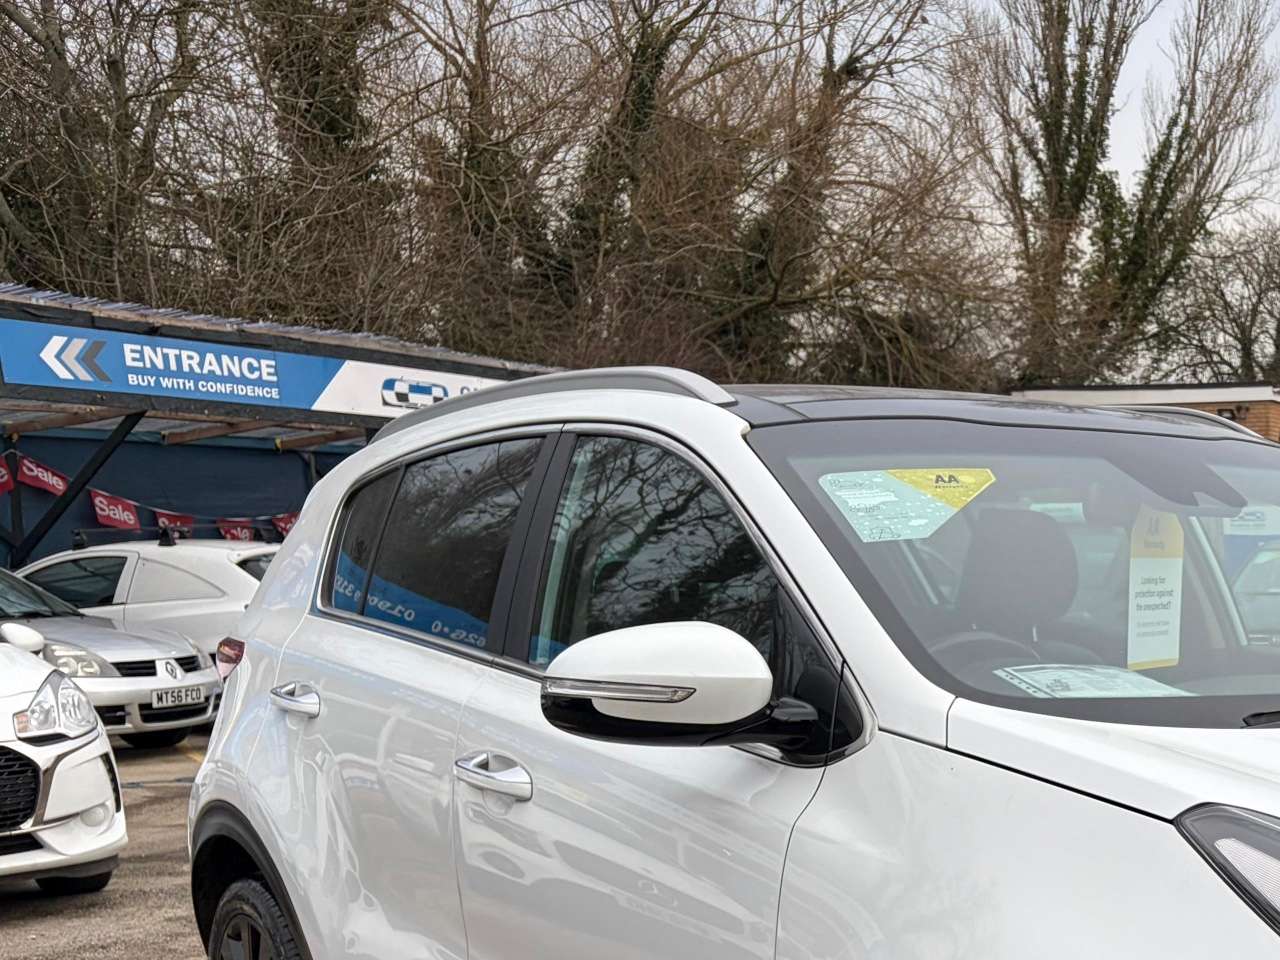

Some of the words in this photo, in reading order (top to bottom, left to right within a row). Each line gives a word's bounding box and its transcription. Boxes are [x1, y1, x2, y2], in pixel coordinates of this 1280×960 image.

[123, 343, 278, 382] ENTRANCE
[127, 373, 156, 388] BUY
[159, 376, 195, 391] WITH
[198, 380, 280, 399] CONFIDENCE
[22, 459, 65, 490] Sale
[93, 496, 136, 525] Sale
[156, 689, 183, 705] MT56
